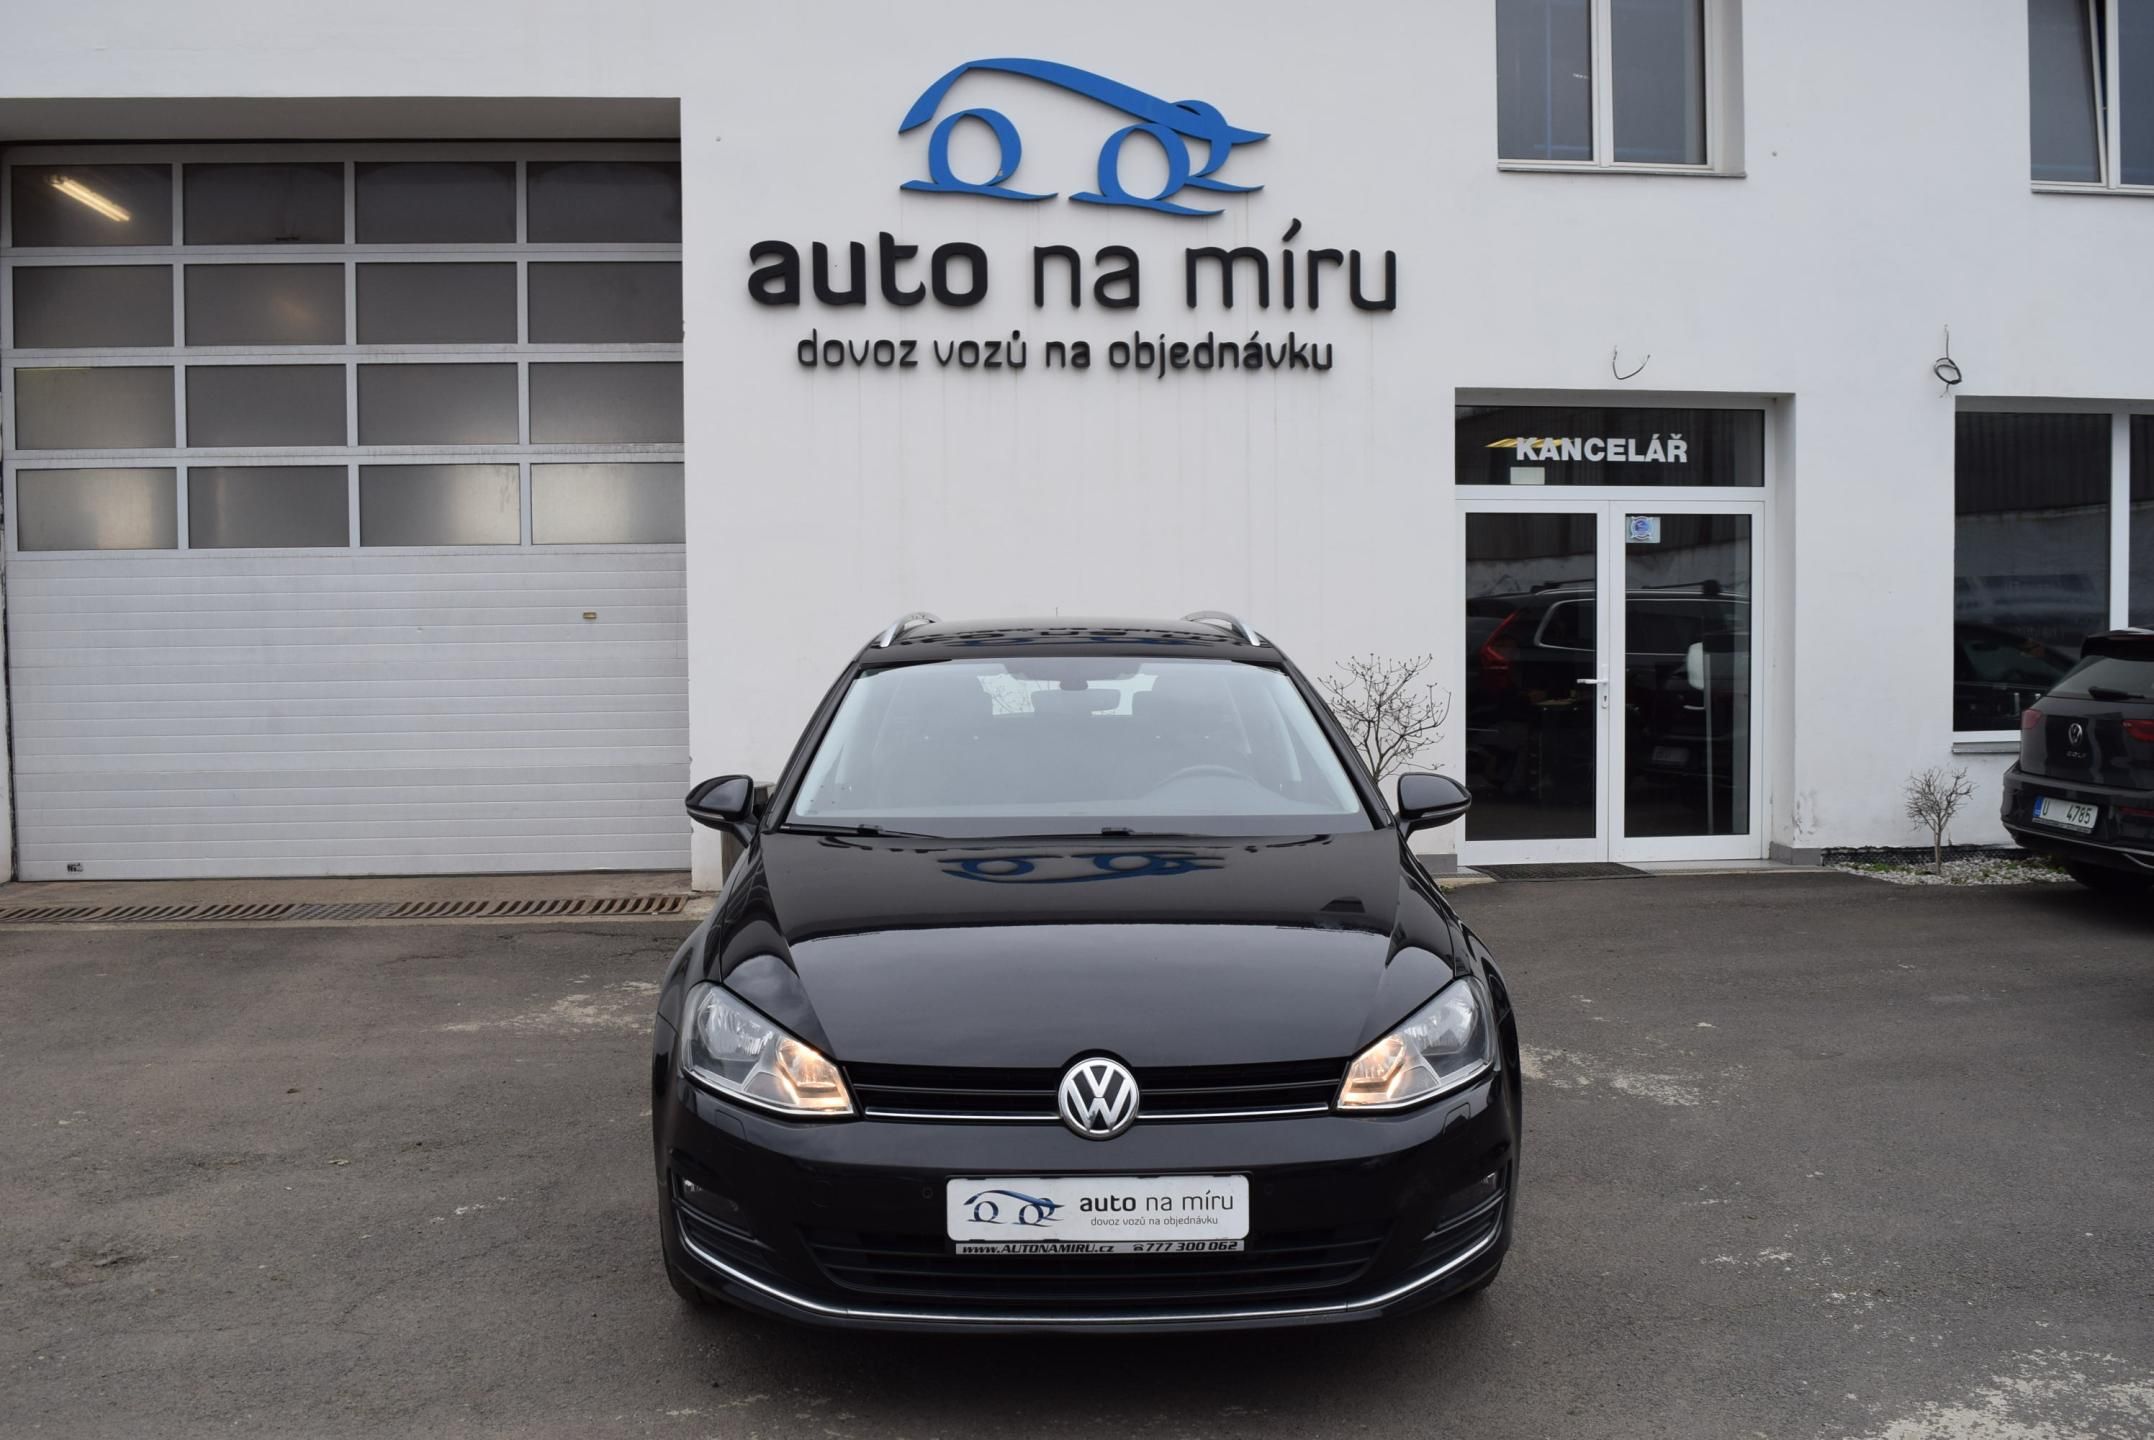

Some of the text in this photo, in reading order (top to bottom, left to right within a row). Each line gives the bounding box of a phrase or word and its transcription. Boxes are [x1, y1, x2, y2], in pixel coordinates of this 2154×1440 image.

[746, 217, 1398, 311] auto na míru
[797, 327, 1334, 380] dovoz vozů na objednávku
[1515, 432, 1689, 463] KANCELÁŘ
[1079, 1189, 1234, 1212] auto na míru
[1090, 1216, 1120, 1226] dovoz
[1149, 1217, 1161, 1226] na
[1163, 1215, 1219, 1228] objednávku
[962, 1243, 1115, 1254] www.AUTONAMIRU.cz
[1145, 1241, 1238, 1252] 777 300 062
